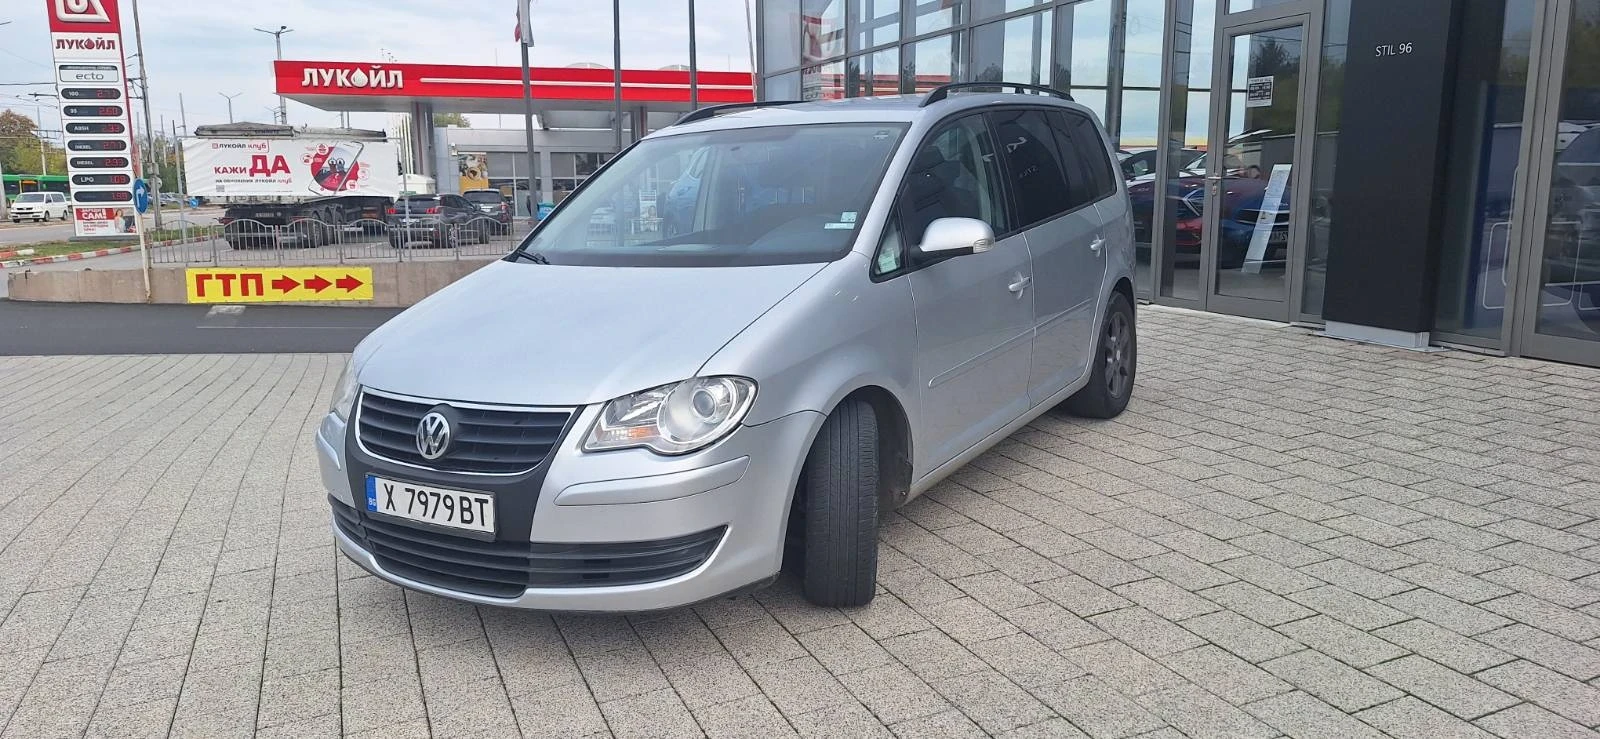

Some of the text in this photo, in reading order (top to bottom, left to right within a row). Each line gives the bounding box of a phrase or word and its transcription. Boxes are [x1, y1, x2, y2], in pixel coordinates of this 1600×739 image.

[56, 37, 115, 50] ЛУКОЙЛ
[1375, 42, 1412, 57] STIL 96
[75, 72, 104, 80] ecto
[301, 65, 404, 89] ЛУКОЙЛ
[214, 154, 291, 177] КАЖИ ДА
[82, 208, 107, 220] САМ!
[195, 273, 264, 297] ГТП
[384, 483, 396, 511] X
